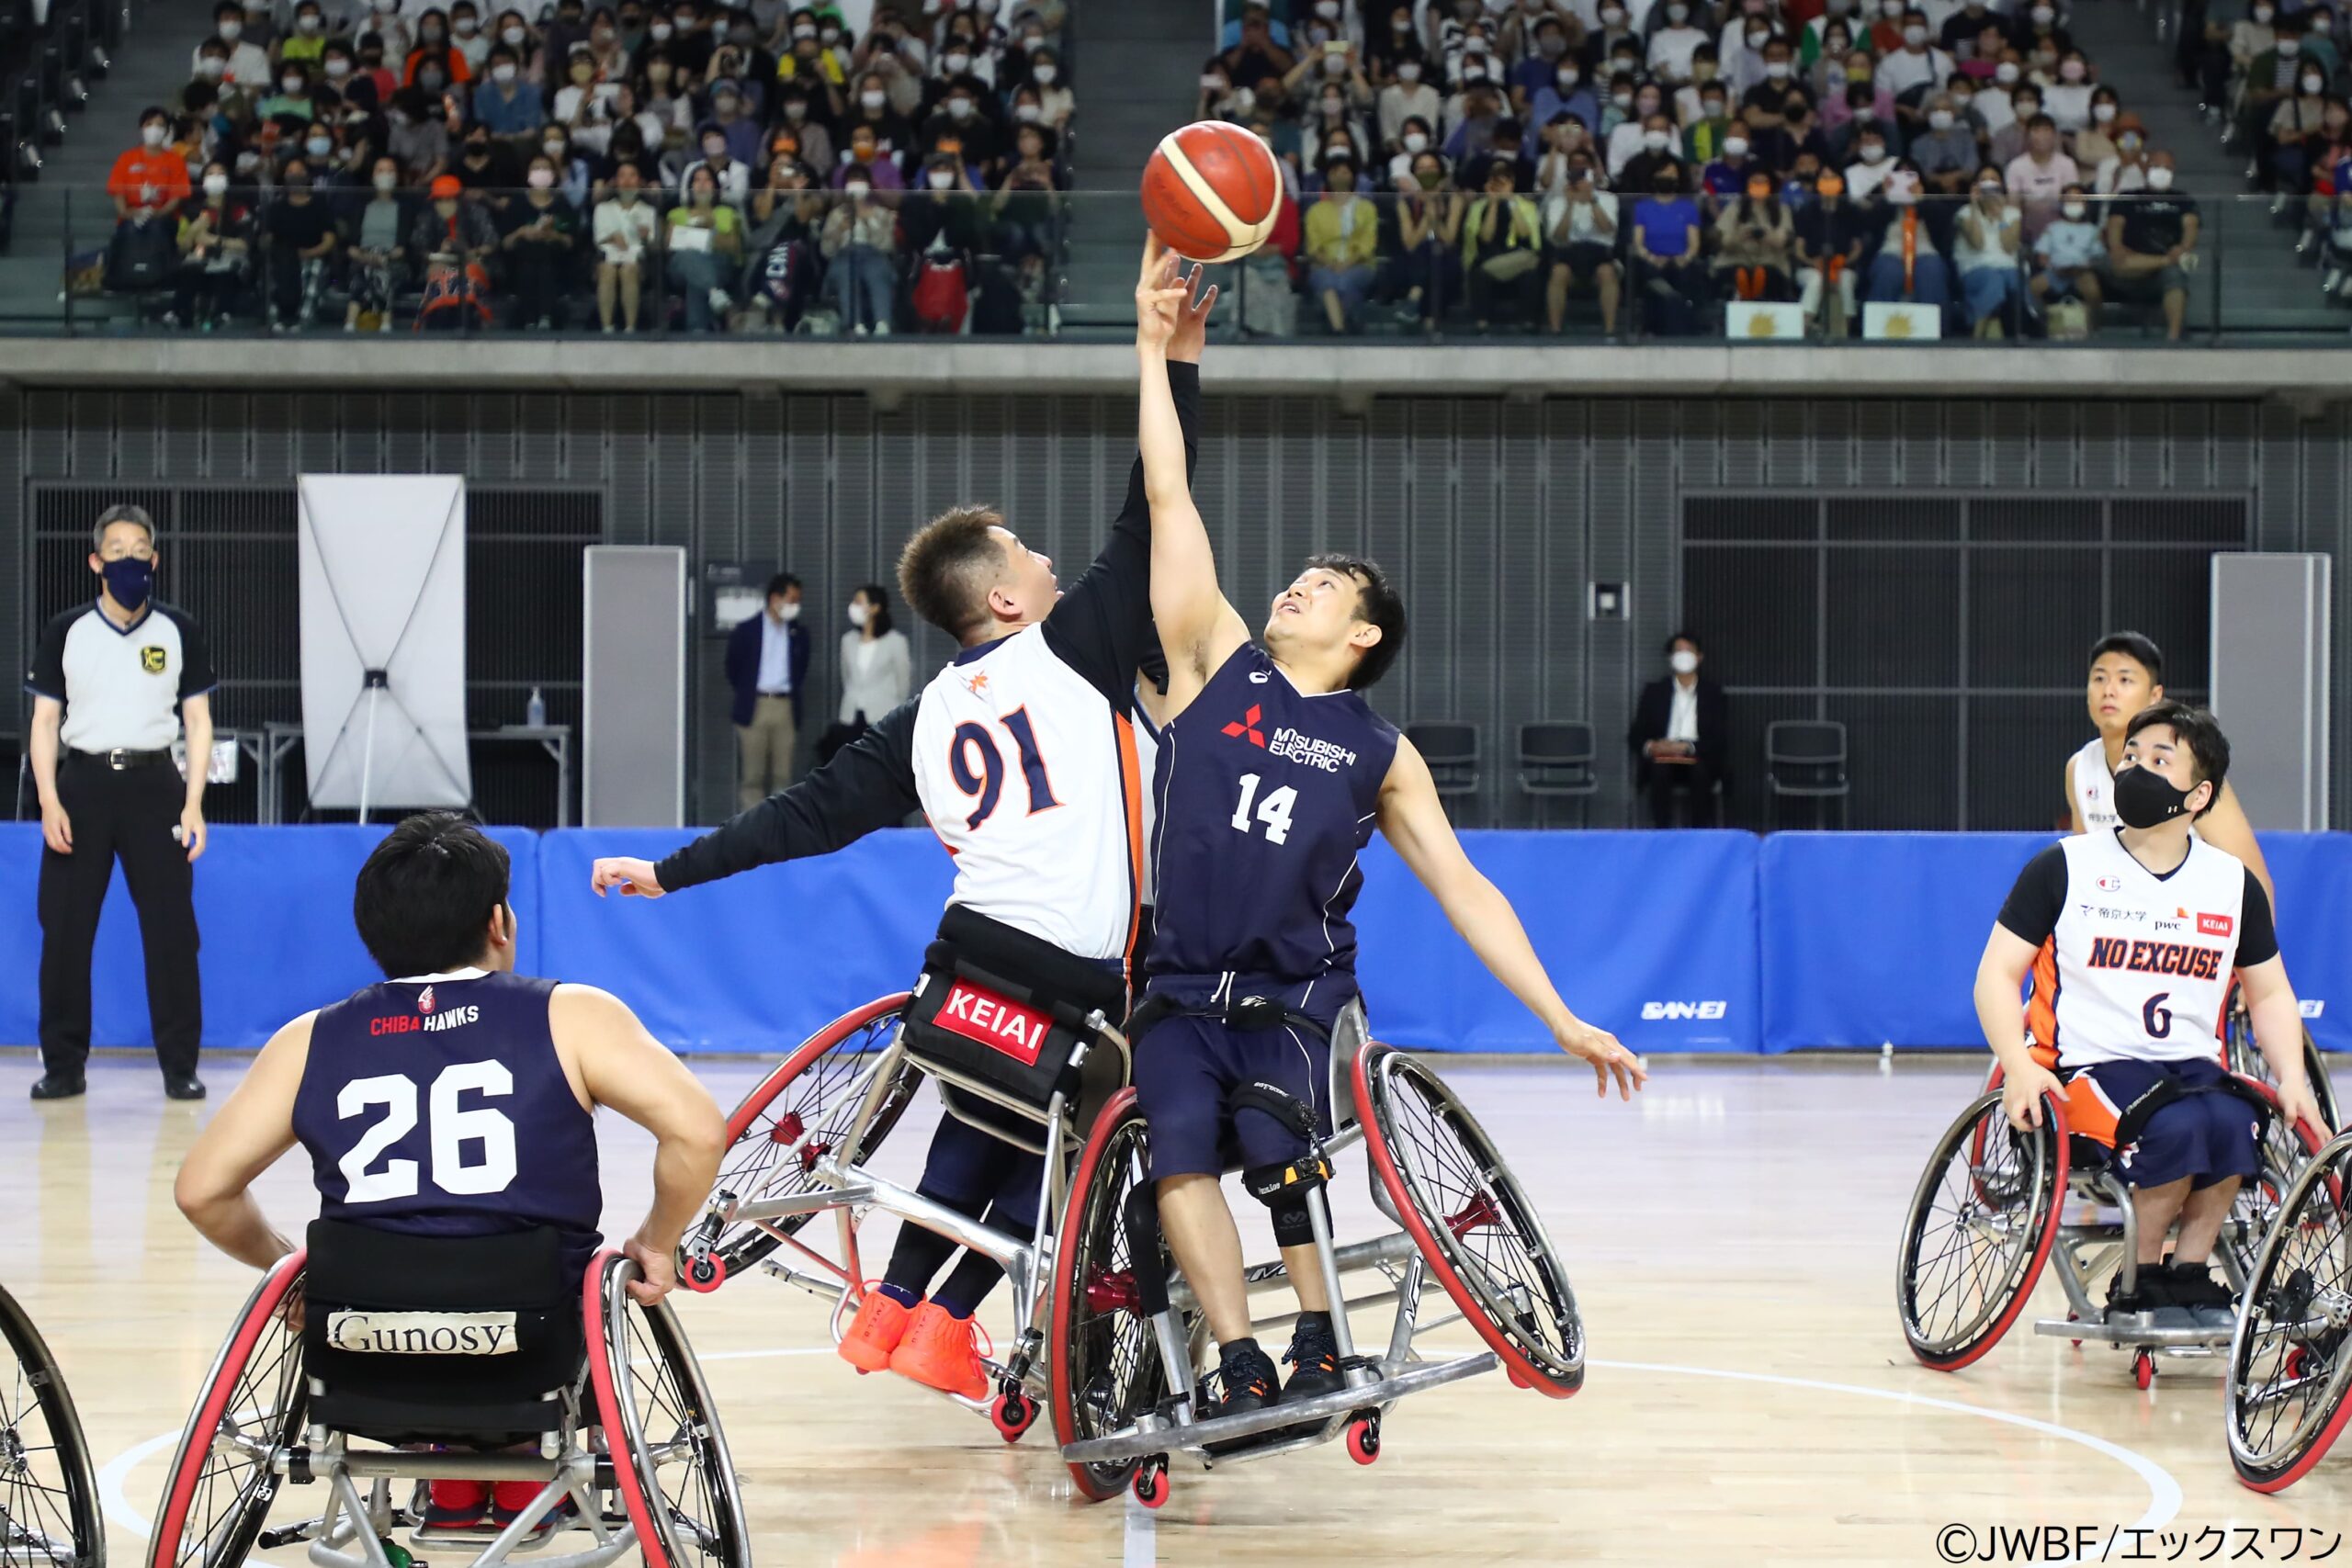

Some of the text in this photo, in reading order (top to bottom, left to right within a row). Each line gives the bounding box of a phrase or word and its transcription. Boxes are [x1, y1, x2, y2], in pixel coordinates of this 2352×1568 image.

[948, 704, 1066, 831] 91
[1268, 740, 1340, 773] ELECTRIC
[1273, 728, 1357, 766] MTSUBISHI
[1231, 773, 1298, 845] 14
[2154, 920, 2181, 931] pwc
[2202, 919, 2229, 931] KEIAI
[2087, 937, 2223, 981] NO EXCUSE
[370, 1006, 480, 1036] CHIBA HAWKS
[946, 988, 1044, 1050] KEIAI
[2143, 992, 2173, 1039] 6
[336, 1059, 517, 1203] 26
[334, 1315, 507, 1354] Gunosy
